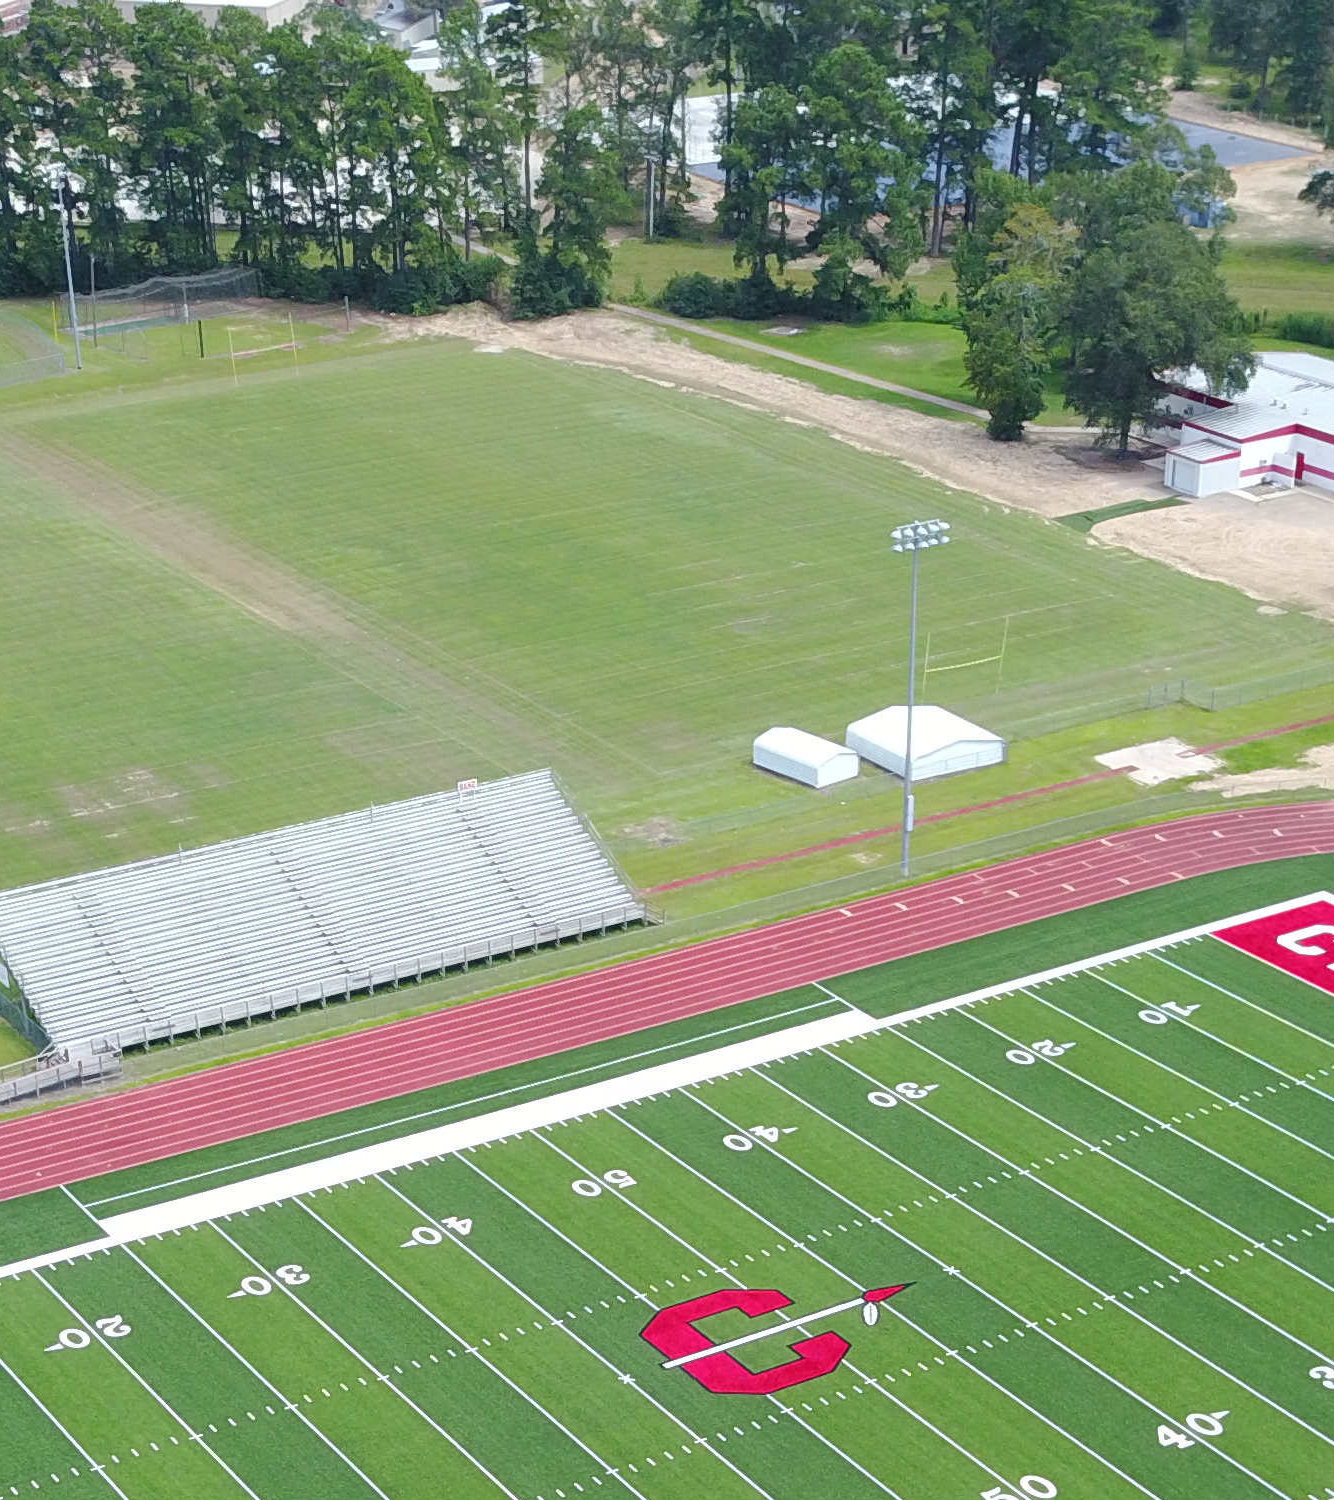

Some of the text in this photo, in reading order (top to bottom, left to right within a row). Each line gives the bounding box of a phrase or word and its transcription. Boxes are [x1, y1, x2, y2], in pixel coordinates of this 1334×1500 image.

[1137, 1001, 1192, 1025] 10
[1006, 1039, 1067, 1066] 20
[868, 1081, 929, 1109] 30
[722, 1124, 782, 1152] 40
[572, 1169, 637, 1197] 50
[411, 1214, 473, 1246] 40
[240, 1263, 311, 1298] 30
[58, 1314, 132, 1351] 20
[1156, 1413, 1224, 1449] 40
